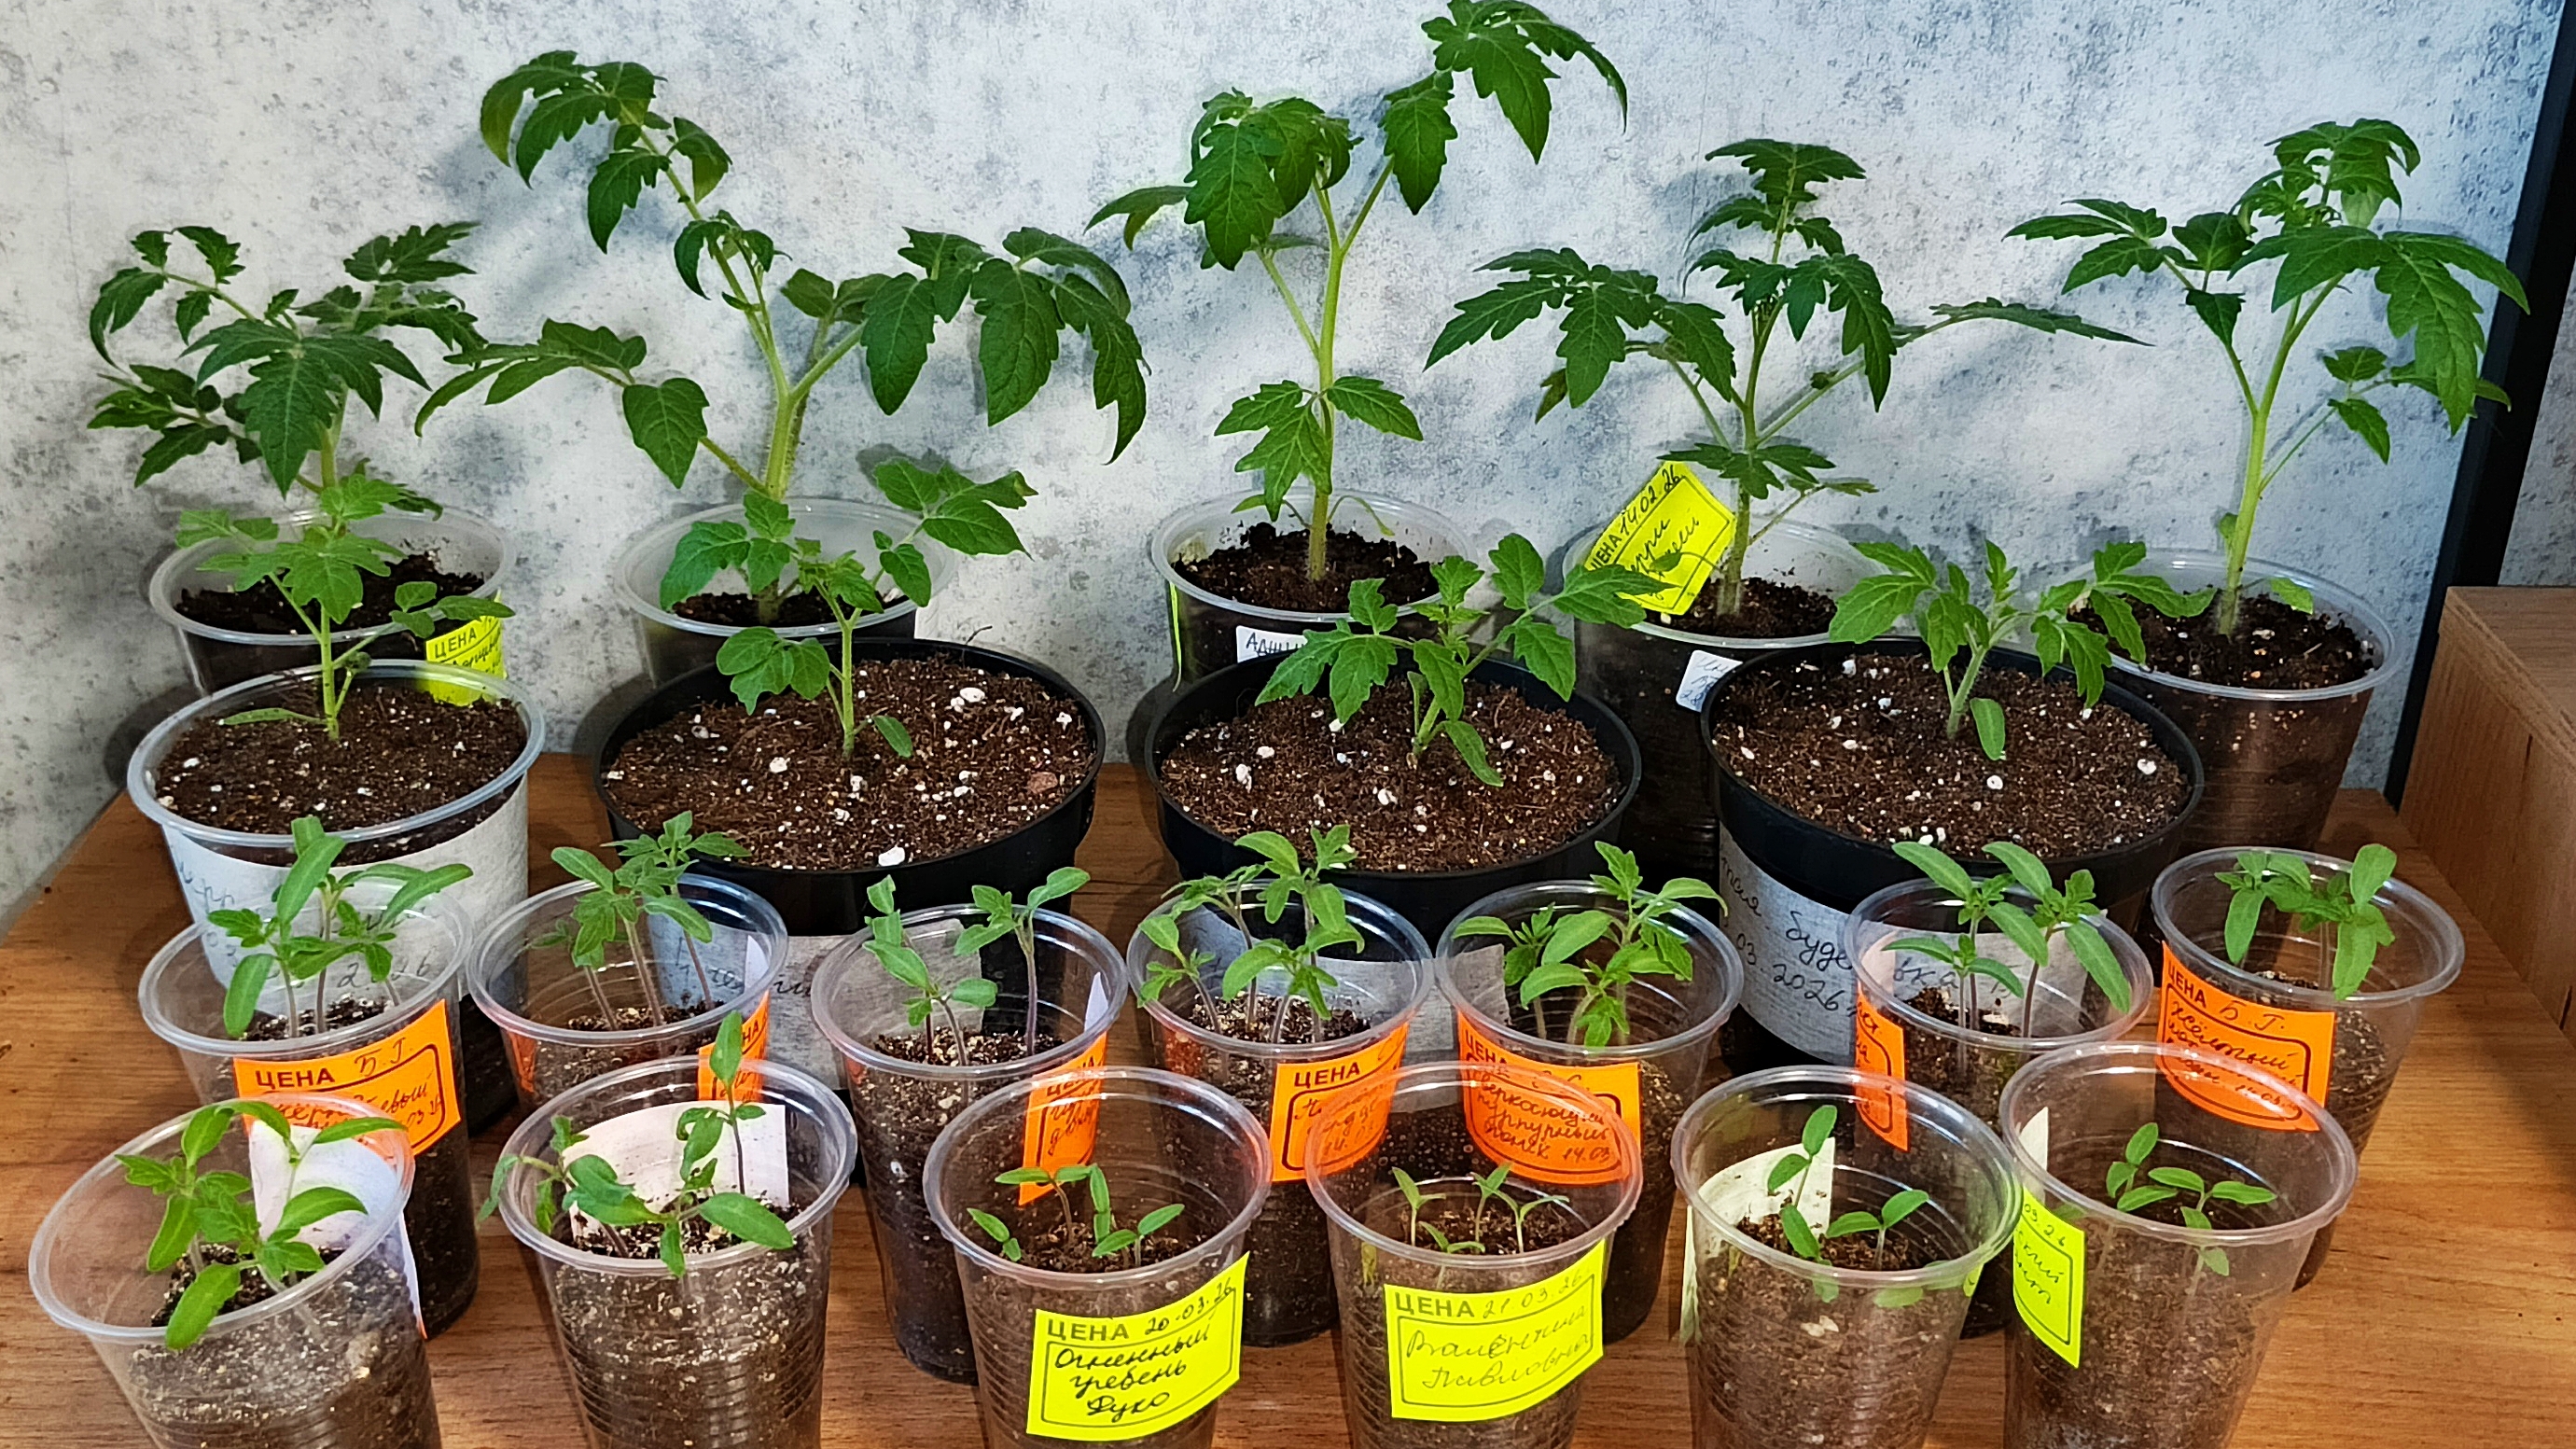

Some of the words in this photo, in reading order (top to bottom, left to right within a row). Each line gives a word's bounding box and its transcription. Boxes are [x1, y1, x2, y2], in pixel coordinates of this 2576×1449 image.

[435, 627, 477, 659] ЦЕНА
[2167, 960, 2207, 1009] ЦЕНА
[742, 1020, 759, 1047] НА
[255, 1067, 336, 1090] ЦЕНА
[1293, 1062, 1360, 1089] ЦЕНА
[1395, 1291, 1475, 1317] ЦЕНА
[1047, 1318, 1130, 1341] ЦЕНА
[1054, 1307, 1218, 1369] Огненный
[1069, 1359, 1187, 1400] гребень
